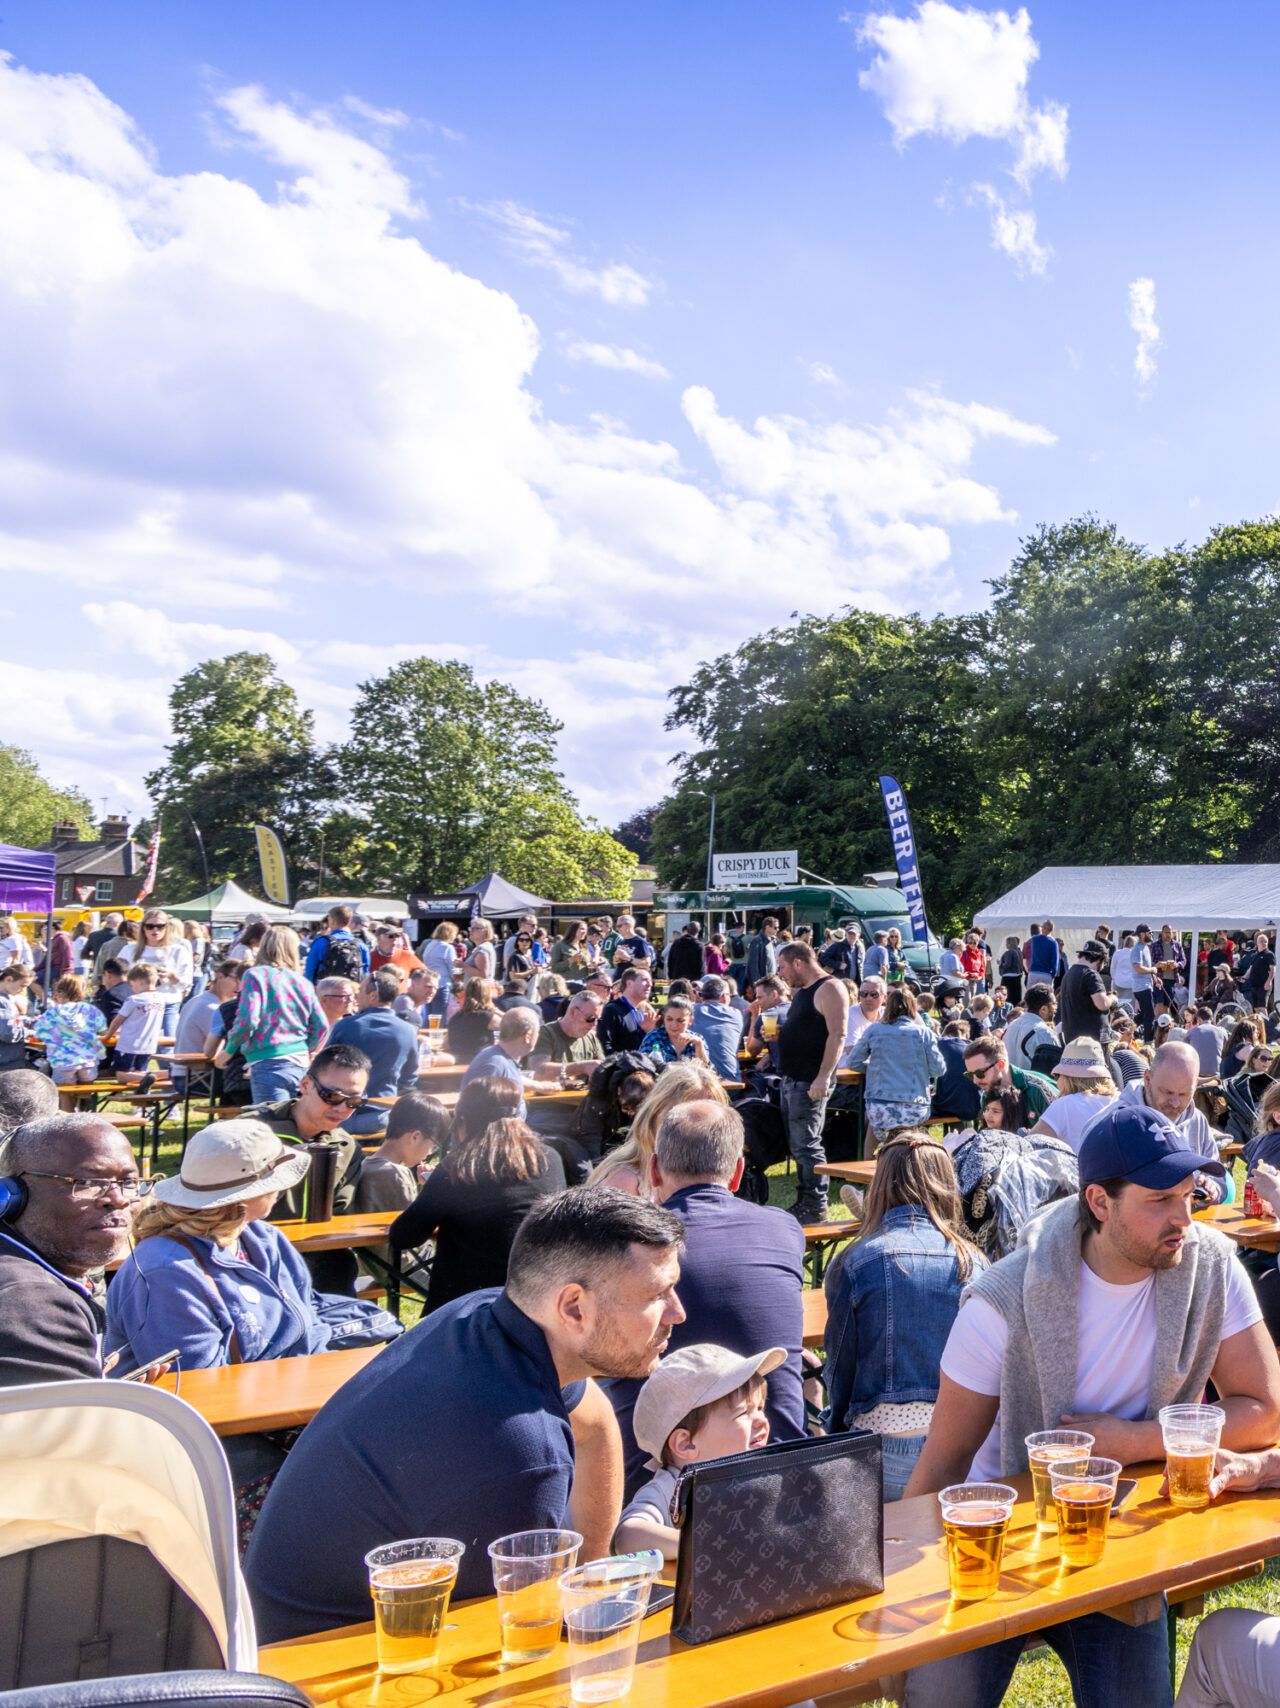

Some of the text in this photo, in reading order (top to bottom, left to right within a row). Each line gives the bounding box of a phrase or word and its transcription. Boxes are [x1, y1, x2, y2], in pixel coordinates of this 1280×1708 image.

[885, 790, 913, 861] BEER
[717, 857, 791, 872] CRISPY DUCK
